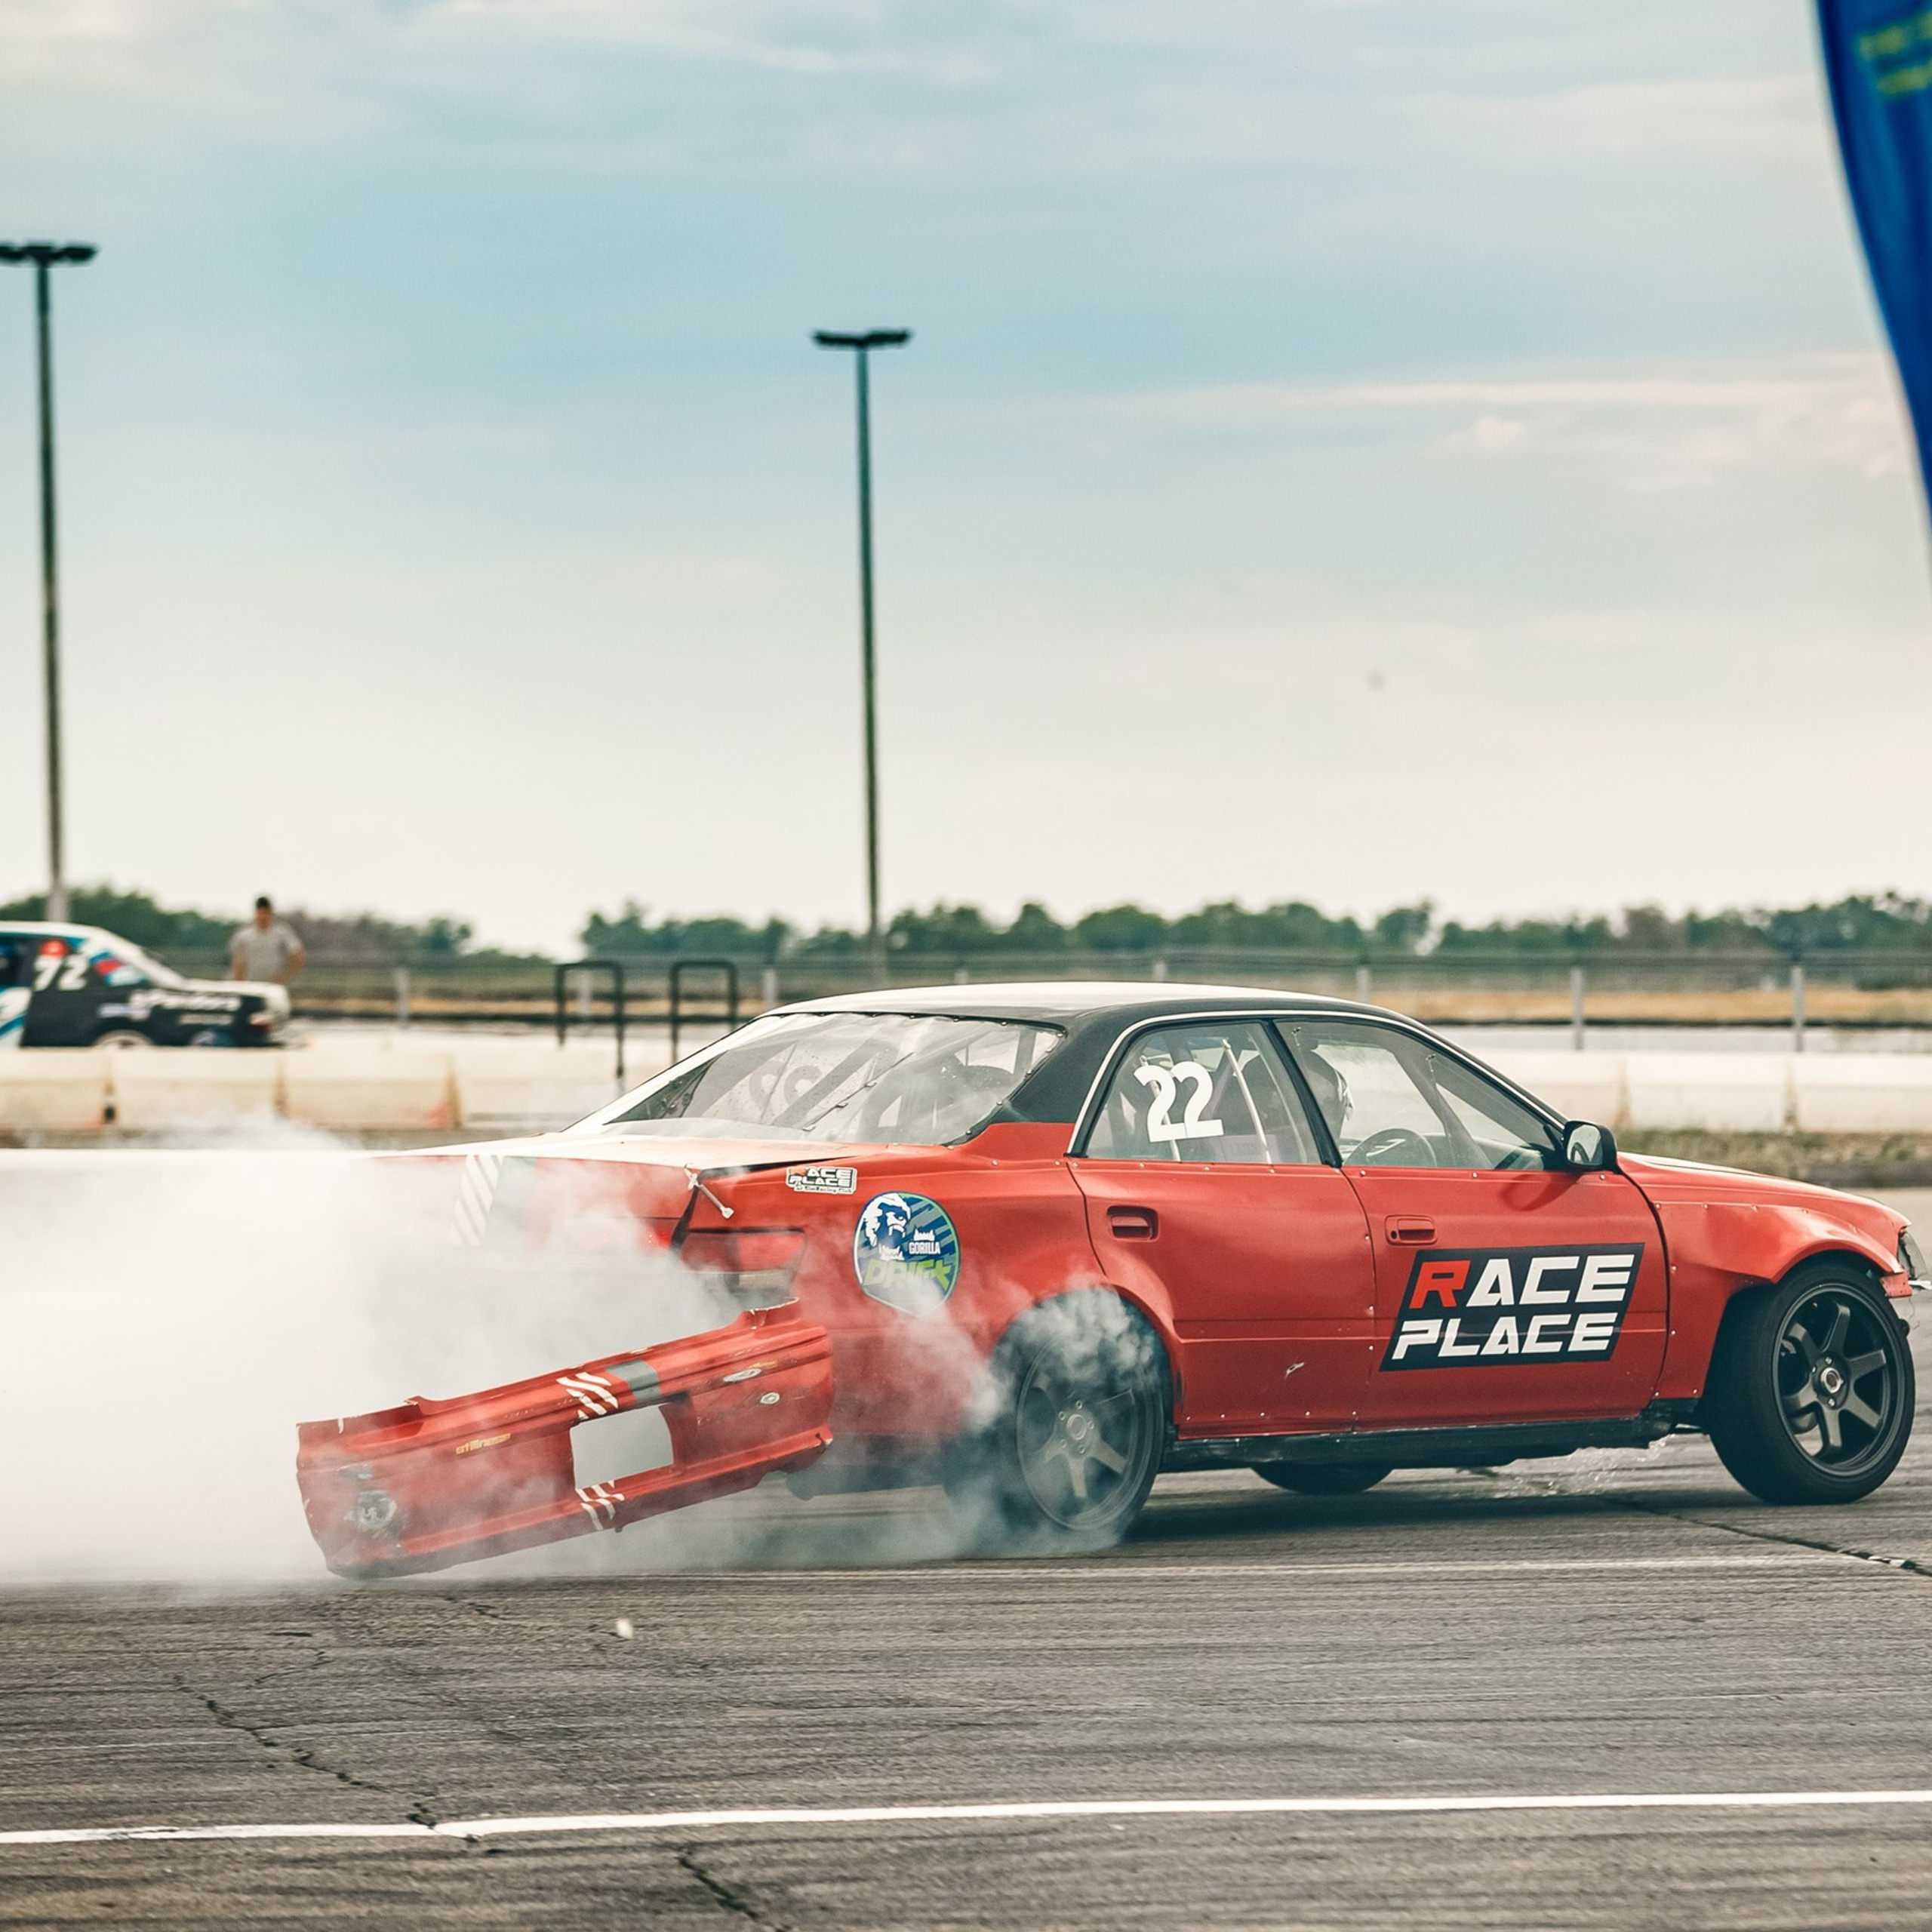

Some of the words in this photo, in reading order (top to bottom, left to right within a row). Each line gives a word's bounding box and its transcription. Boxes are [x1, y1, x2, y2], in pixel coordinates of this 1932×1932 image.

[1134, 1061, 1224, 1143] 22
[909, 1241, 941, 1255] GORILLA
[1409, 1254, 1635, 1309] RACE
[1392, 1312, 1618, 1359] PLACE
